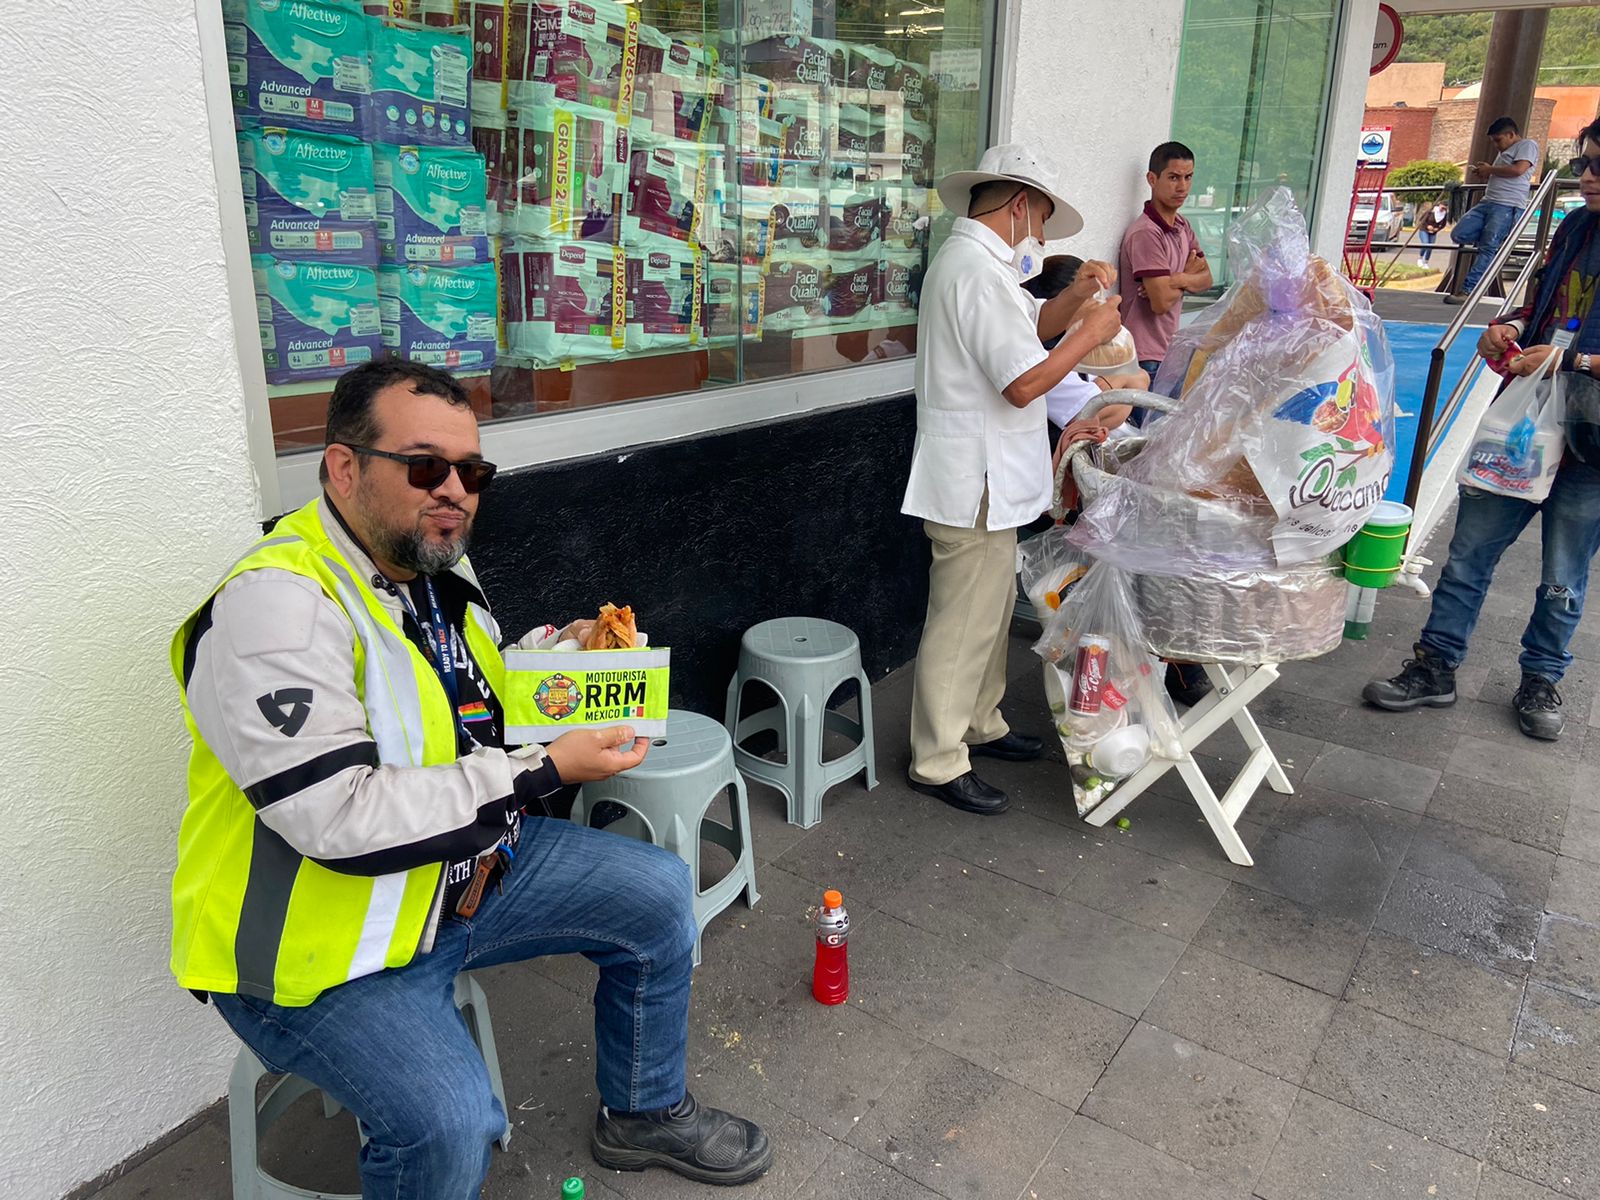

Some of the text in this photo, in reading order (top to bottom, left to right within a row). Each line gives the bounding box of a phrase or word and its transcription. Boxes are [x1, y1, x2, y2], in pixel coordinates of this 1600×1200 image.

[289, 2, 341, 24] Affective
[570, 6, 594, 20] Depend
[625, 21, 638, 82] GRATIS
[803, 48, 828, 67] Facial
[260, 80, 312, 96] Advanced
[290, 100, 319, 110] 10 M
[295, 143, 347, 162] Affective
[555, 123, 569, 200] GRATIS 2
[426, 164, 467, 181] Affective
[270, 219, 320, 230] Advanced
[786, 215, 818, 232] Quality
[320, 232, 328, 240] M
[405, 234, 445, 244] Advanced
[561, 250, 584, 260] Depend
[650, 256, 670, 265] Depend
[306, 265, 354, 282] Affective
[796, 270, 820, 284] Facial
[854, 273, 868, 283] Facial
[433, 276, 475, 290] Affective
[694, 256, 702, 307] GRATIS
[616, 253, 624, 325] 2 GRATIS
[790, 285, 822, 302] Quality
[288, 338, 333, 351] Advanced
[411, 341, 451, 350] Advanced
[441, 644, 448, 652] TO
[442, 651, 452, 673] READY
[586, 671, 647, 683] MOTOTURISTA
[585, 682, 646, 708] RRM
[585, 708, 620, 721] MÉXICO
[827, 934, 839, 945] G
